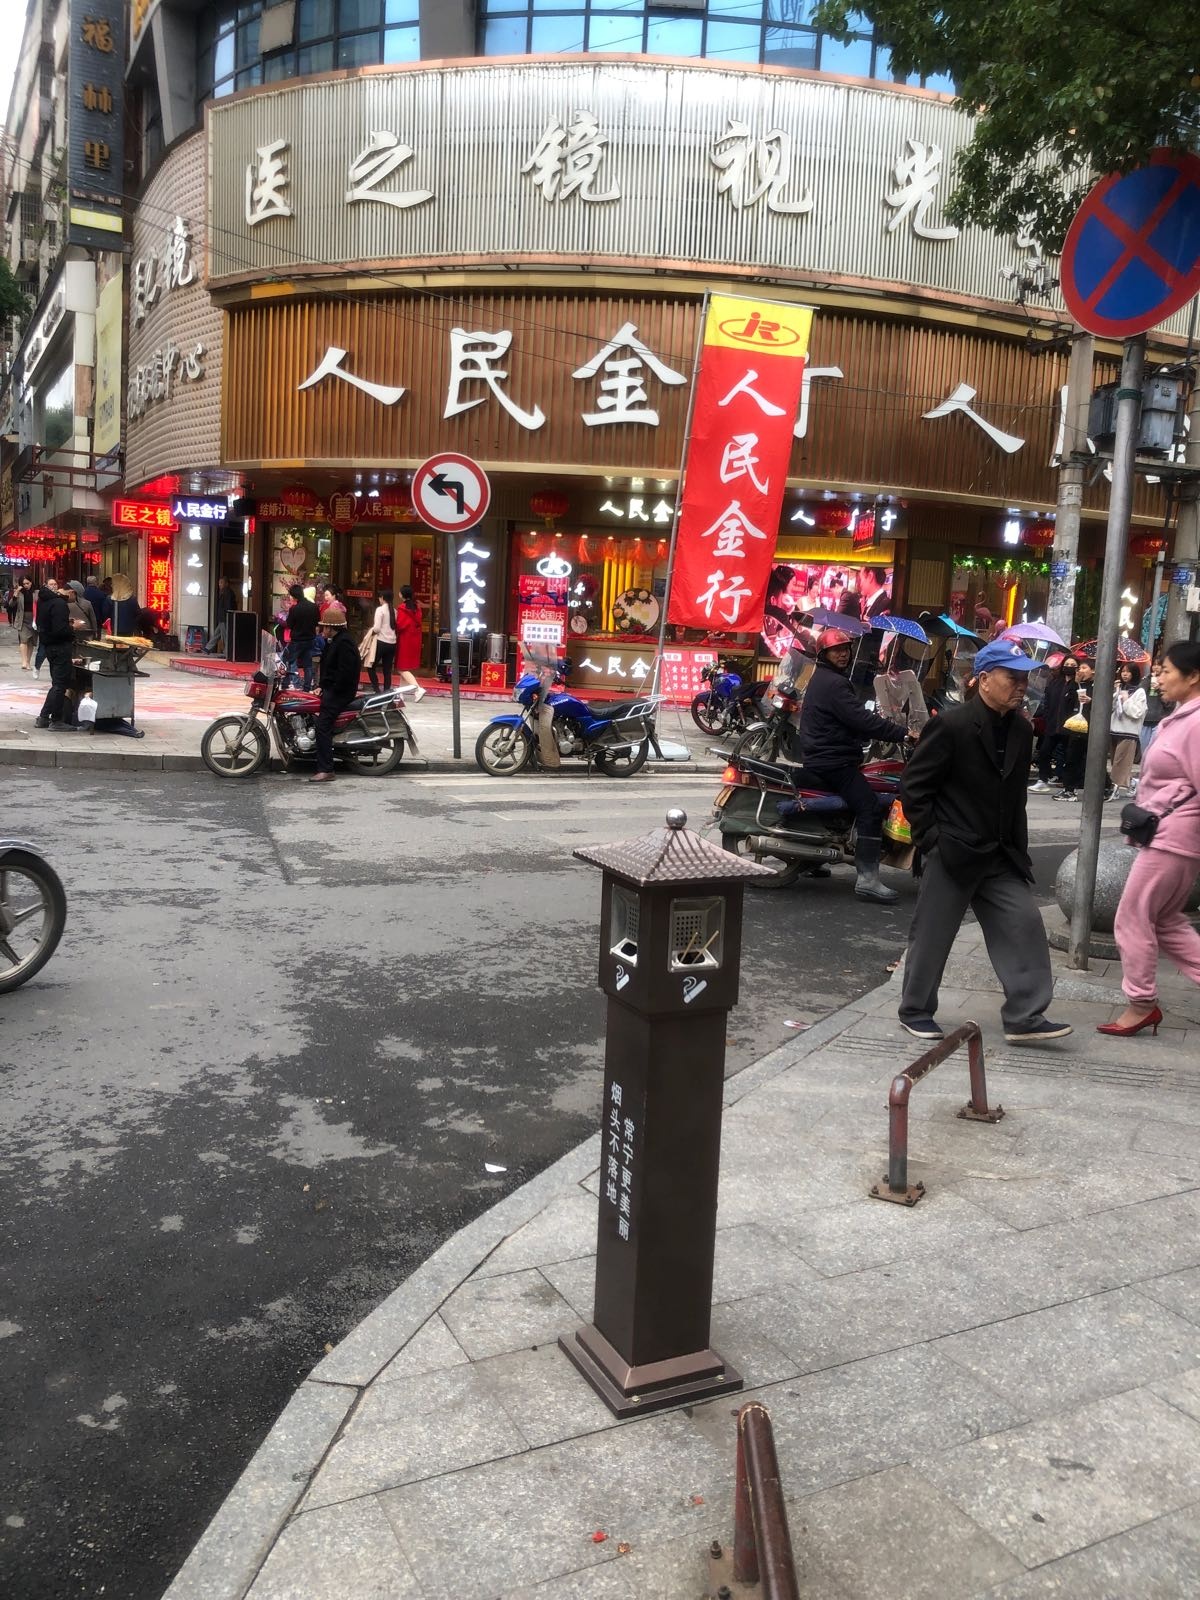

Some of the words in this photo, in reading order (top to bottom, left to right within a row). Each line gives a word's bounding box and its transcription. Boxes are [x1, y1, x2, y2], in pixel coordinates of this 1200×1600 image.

[80, 15, 115, 170] 福林里
[246, 109, 1048, 287] 医之镜视光
[120, 504, 174, 526] 医之镜
[173, 501, 228, 520] 人民金行
[599, 498, 683, 522] 人民金
[695, 369, 787, 625] 人民金行
[151, 559, 170, 630] 潮童社
[457, 540, 491, 635] 人民金行
[579, 655, 657, 679] 人民金
[606, 1081, 623, 1205] 烟头不落地
